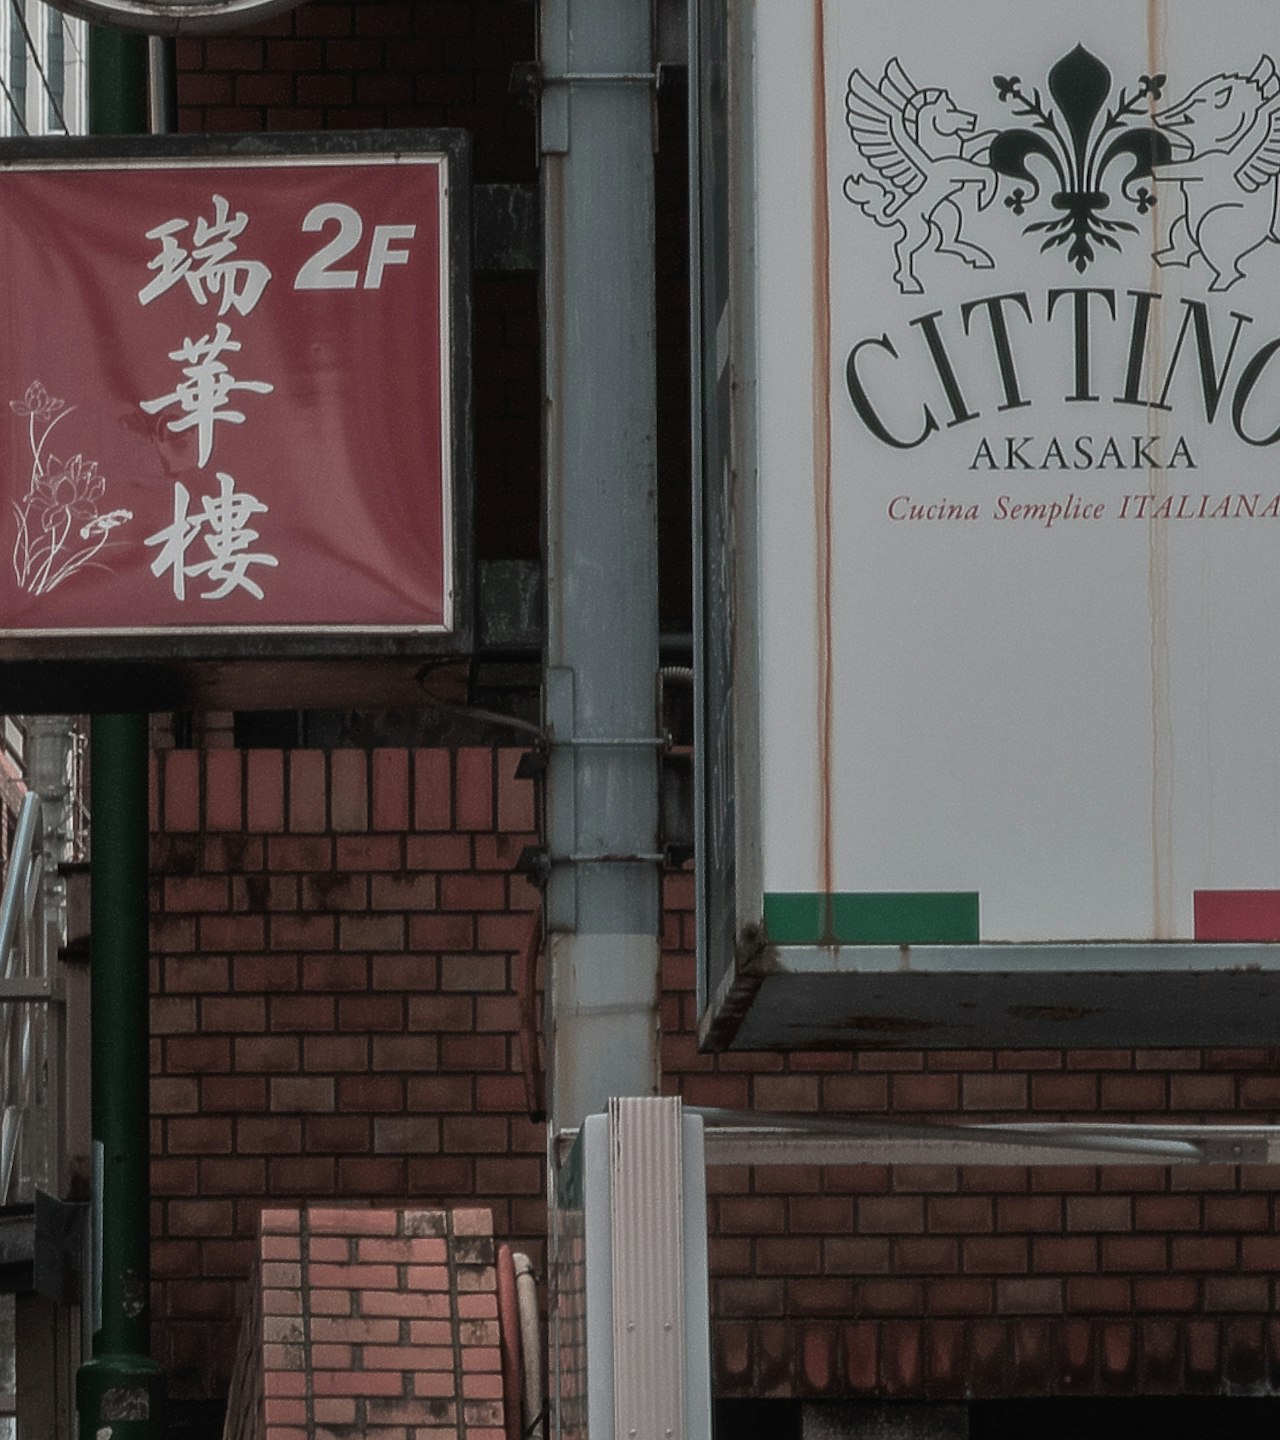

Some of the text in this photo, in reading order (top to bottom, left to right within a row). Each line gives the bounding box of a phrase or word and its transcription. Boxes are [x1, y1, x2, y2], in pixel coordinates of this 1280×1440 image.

[294, 202, 417, 291] 2F
[969, 435, 1199, 471] AKASAKA
[887, 492, 1280, 528] Cucina Semplice ITALIANA
